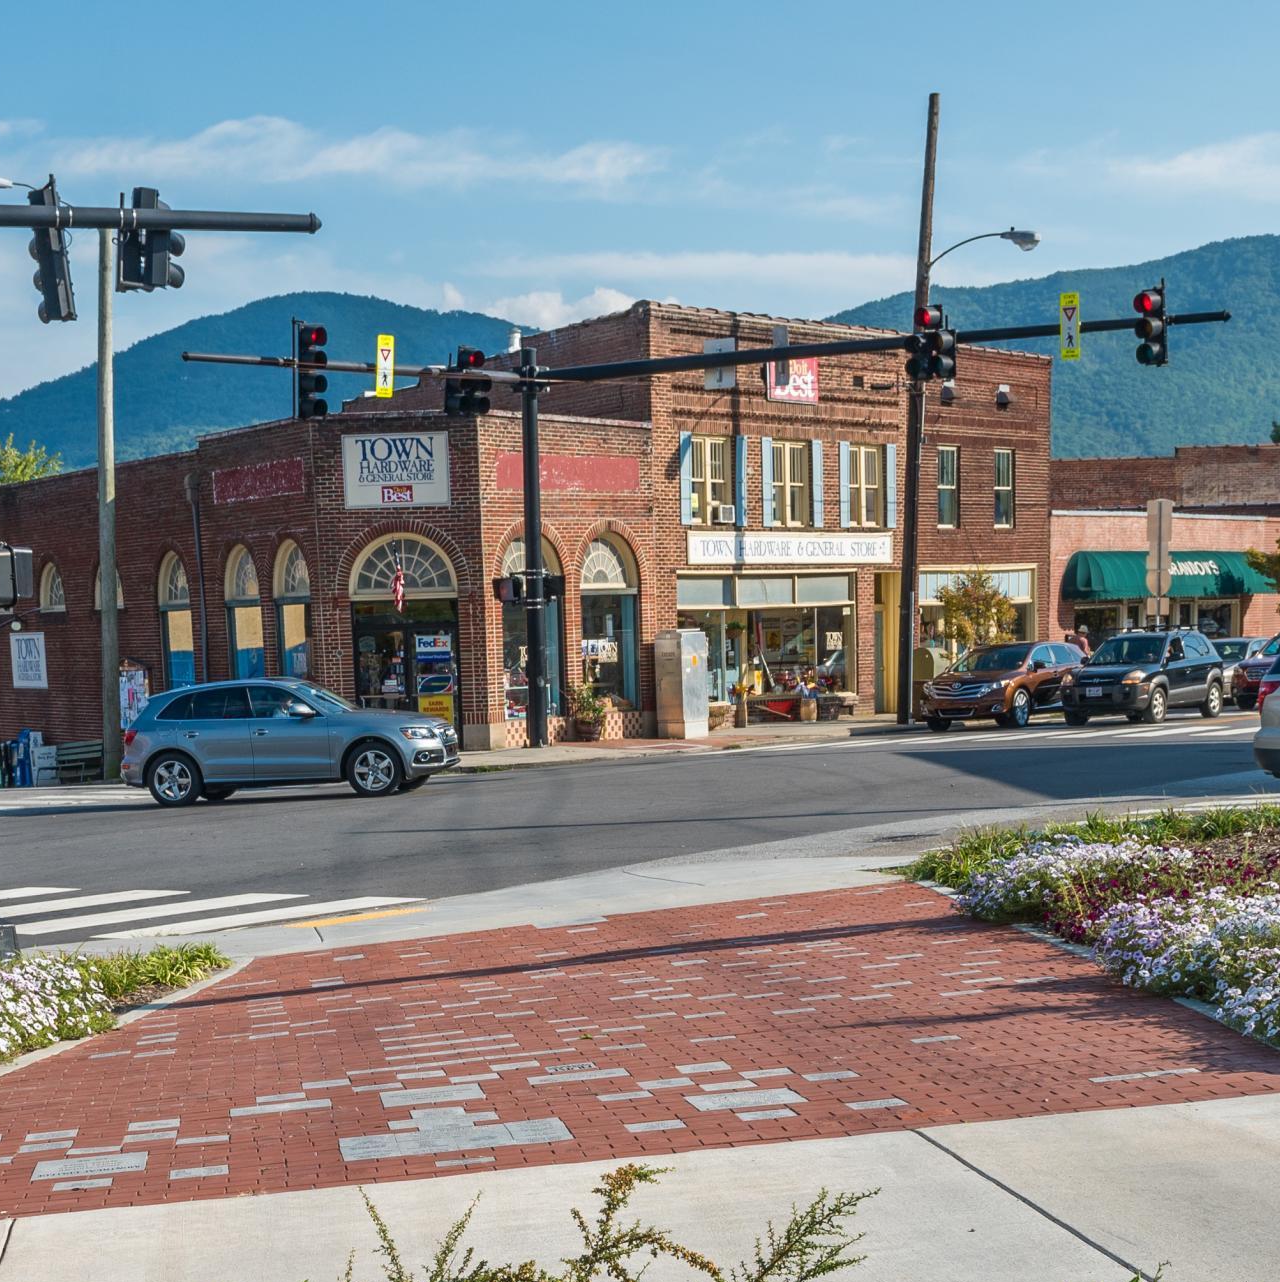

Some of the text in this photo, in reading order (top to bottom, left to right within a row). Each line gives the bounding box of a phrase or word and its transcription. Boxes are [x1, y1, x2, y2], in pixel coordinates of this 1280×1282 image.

[355, 437, 434, 461] TOWN
[360, 459, 434, 474] HARDWARE
[365, 473, 404, 483] GENERAL
[406, 472, 434, 481] STORE
[383, 487, 412, 502] Best
[699, 539, 733, 557] TOWN
[738, 540, 792, 557] HARDWARE
[804, 541, 844, 557] GENERAL
[849, 541, 878, 557] STORE
[15, 638, 41, 660] TOWN
[417, 637, 448, 648] FedEx
